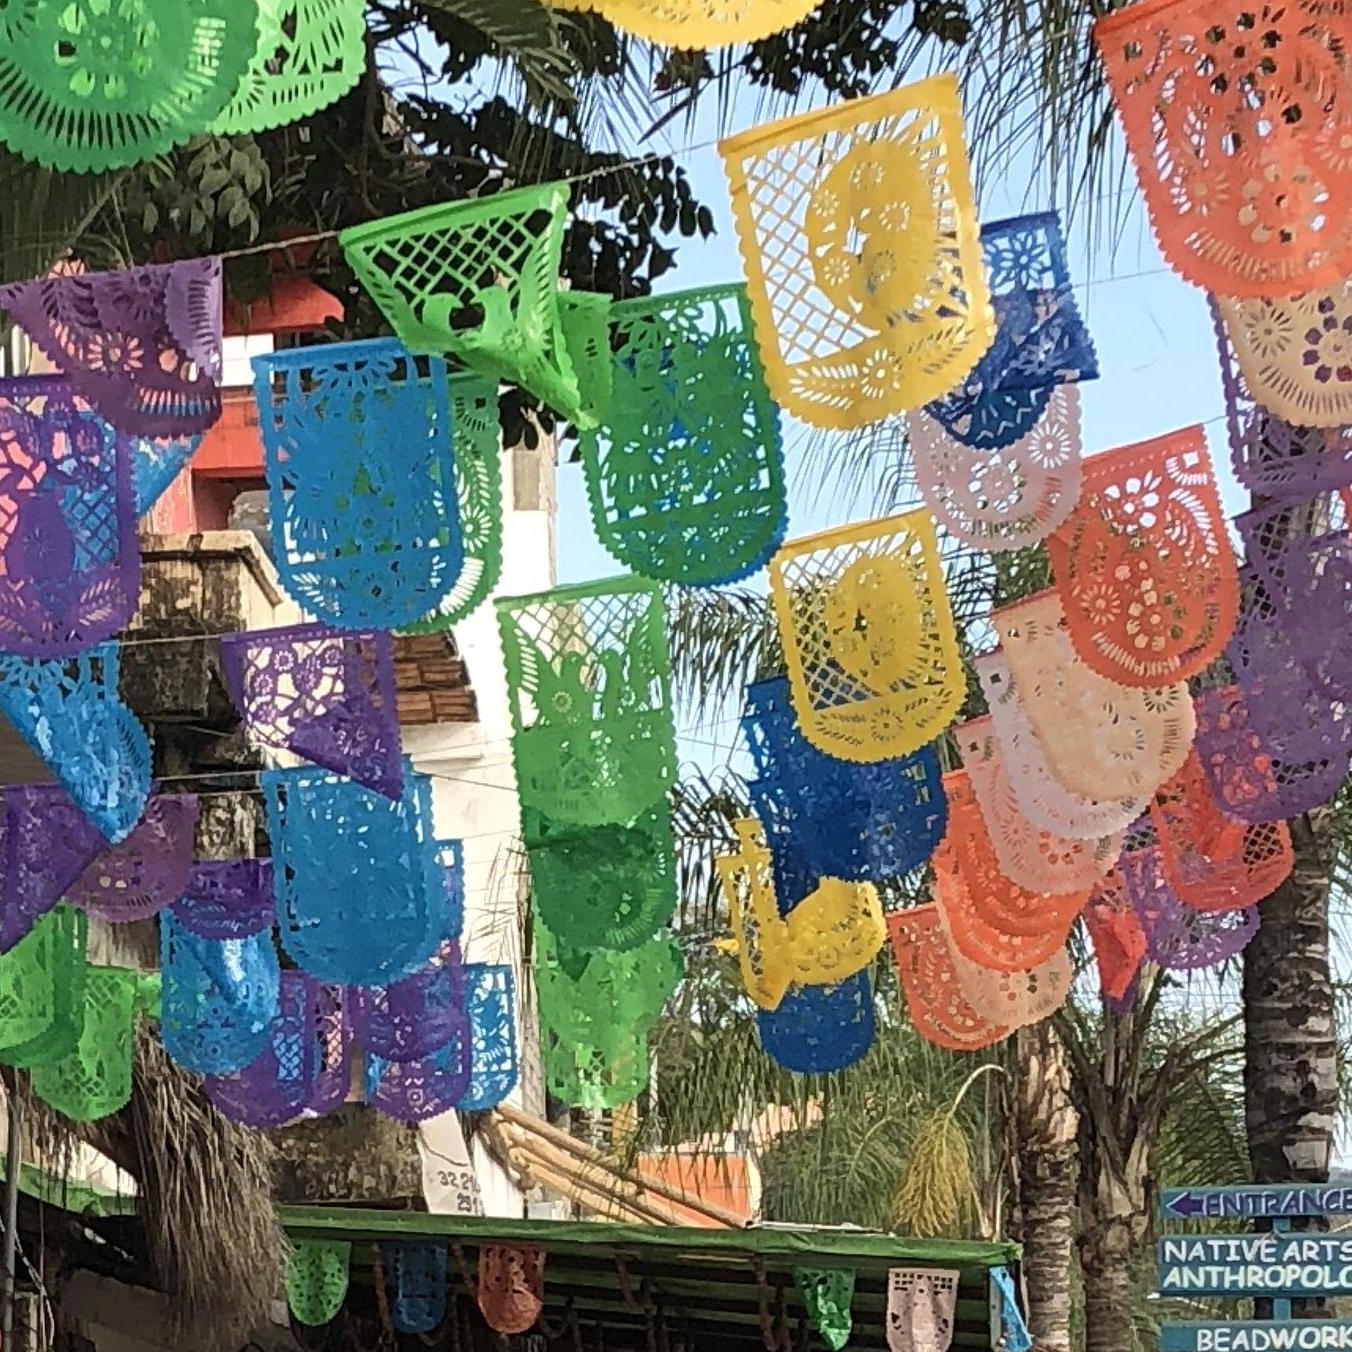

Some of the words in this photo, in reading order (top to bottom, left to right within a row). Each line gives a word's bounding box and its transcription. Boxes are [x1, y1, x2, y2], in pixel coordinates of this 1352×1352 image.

[1202, 1188, 1352, 1217] ENTRANCE
[1164, 1239, 1277, 1263] NATIVE
[1282, 1239, 1352, 1263] ARTS
[1196, 1326, 1352, 1352] BEADWORK
